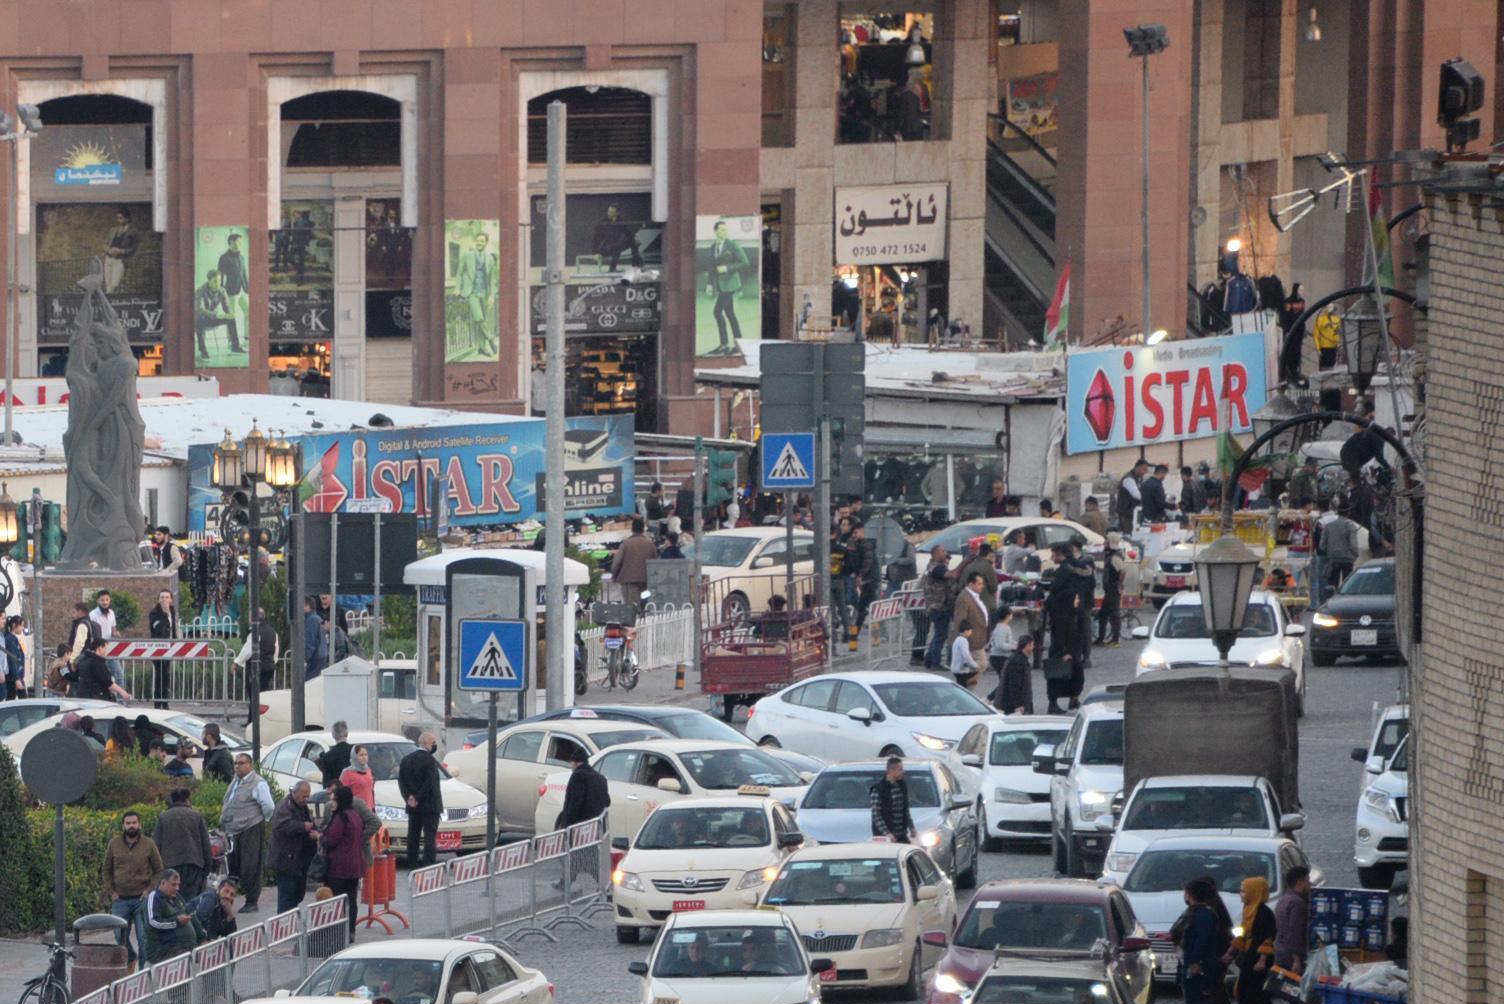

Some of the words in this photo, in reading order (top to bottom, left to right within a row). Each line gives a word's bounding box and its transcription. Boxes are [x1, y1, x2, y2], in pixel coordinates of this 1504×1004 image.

[852, 246, 877, 257] 0750
[880, 245, 898, 256] 472
[903, 243, 927, 254] 1524
[625, 288, 657, 302] D&G
[591, 304, 627, 314] GUCCI
[378, 440, 403, 453] Digital
[404, 440, 410, 450] &
[412, 437, 442, 449] Android
[444, 436, 474, 448] Satellite
[475, 434, 509, 446] Receiver
